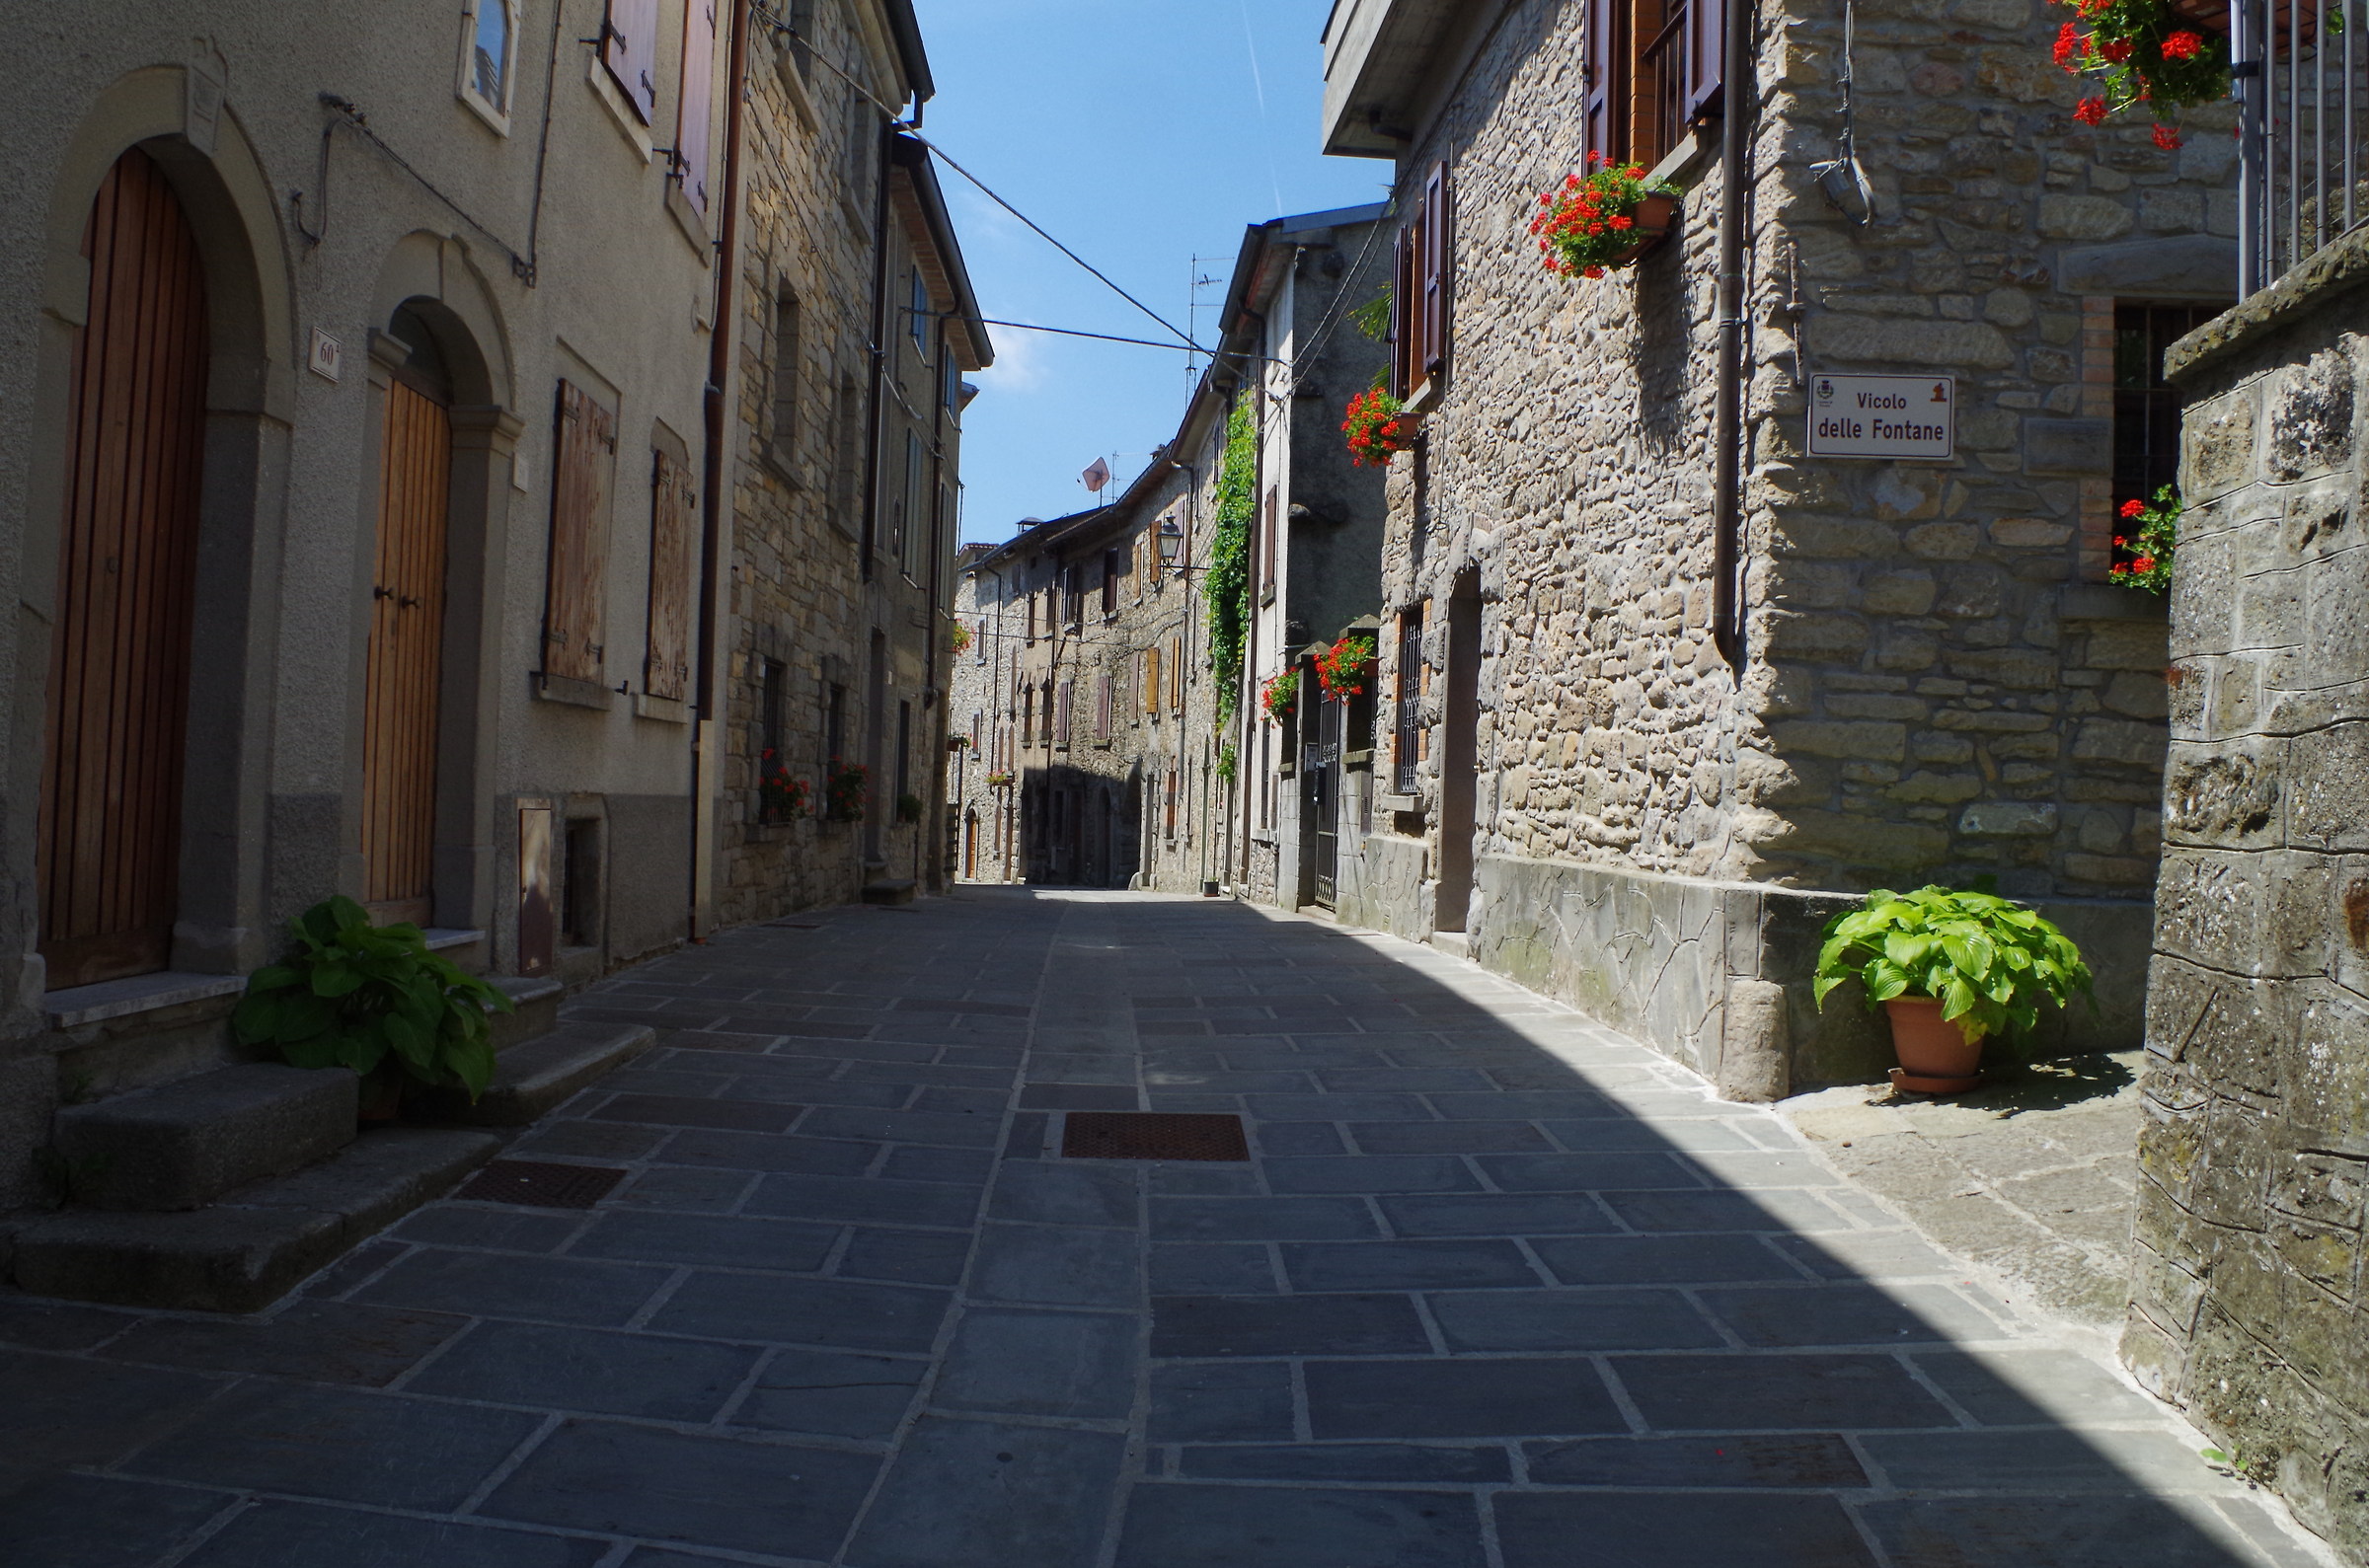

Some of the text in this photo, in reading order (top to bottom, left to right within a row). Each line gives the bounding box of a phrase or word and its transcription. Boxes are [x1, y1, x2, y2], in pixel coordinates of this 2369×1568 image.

[321, 341, 334, 364] 60
[1857, 393, 1907, 410] Vicolo
[1818, 417, 1944, 440] delle Fontane
